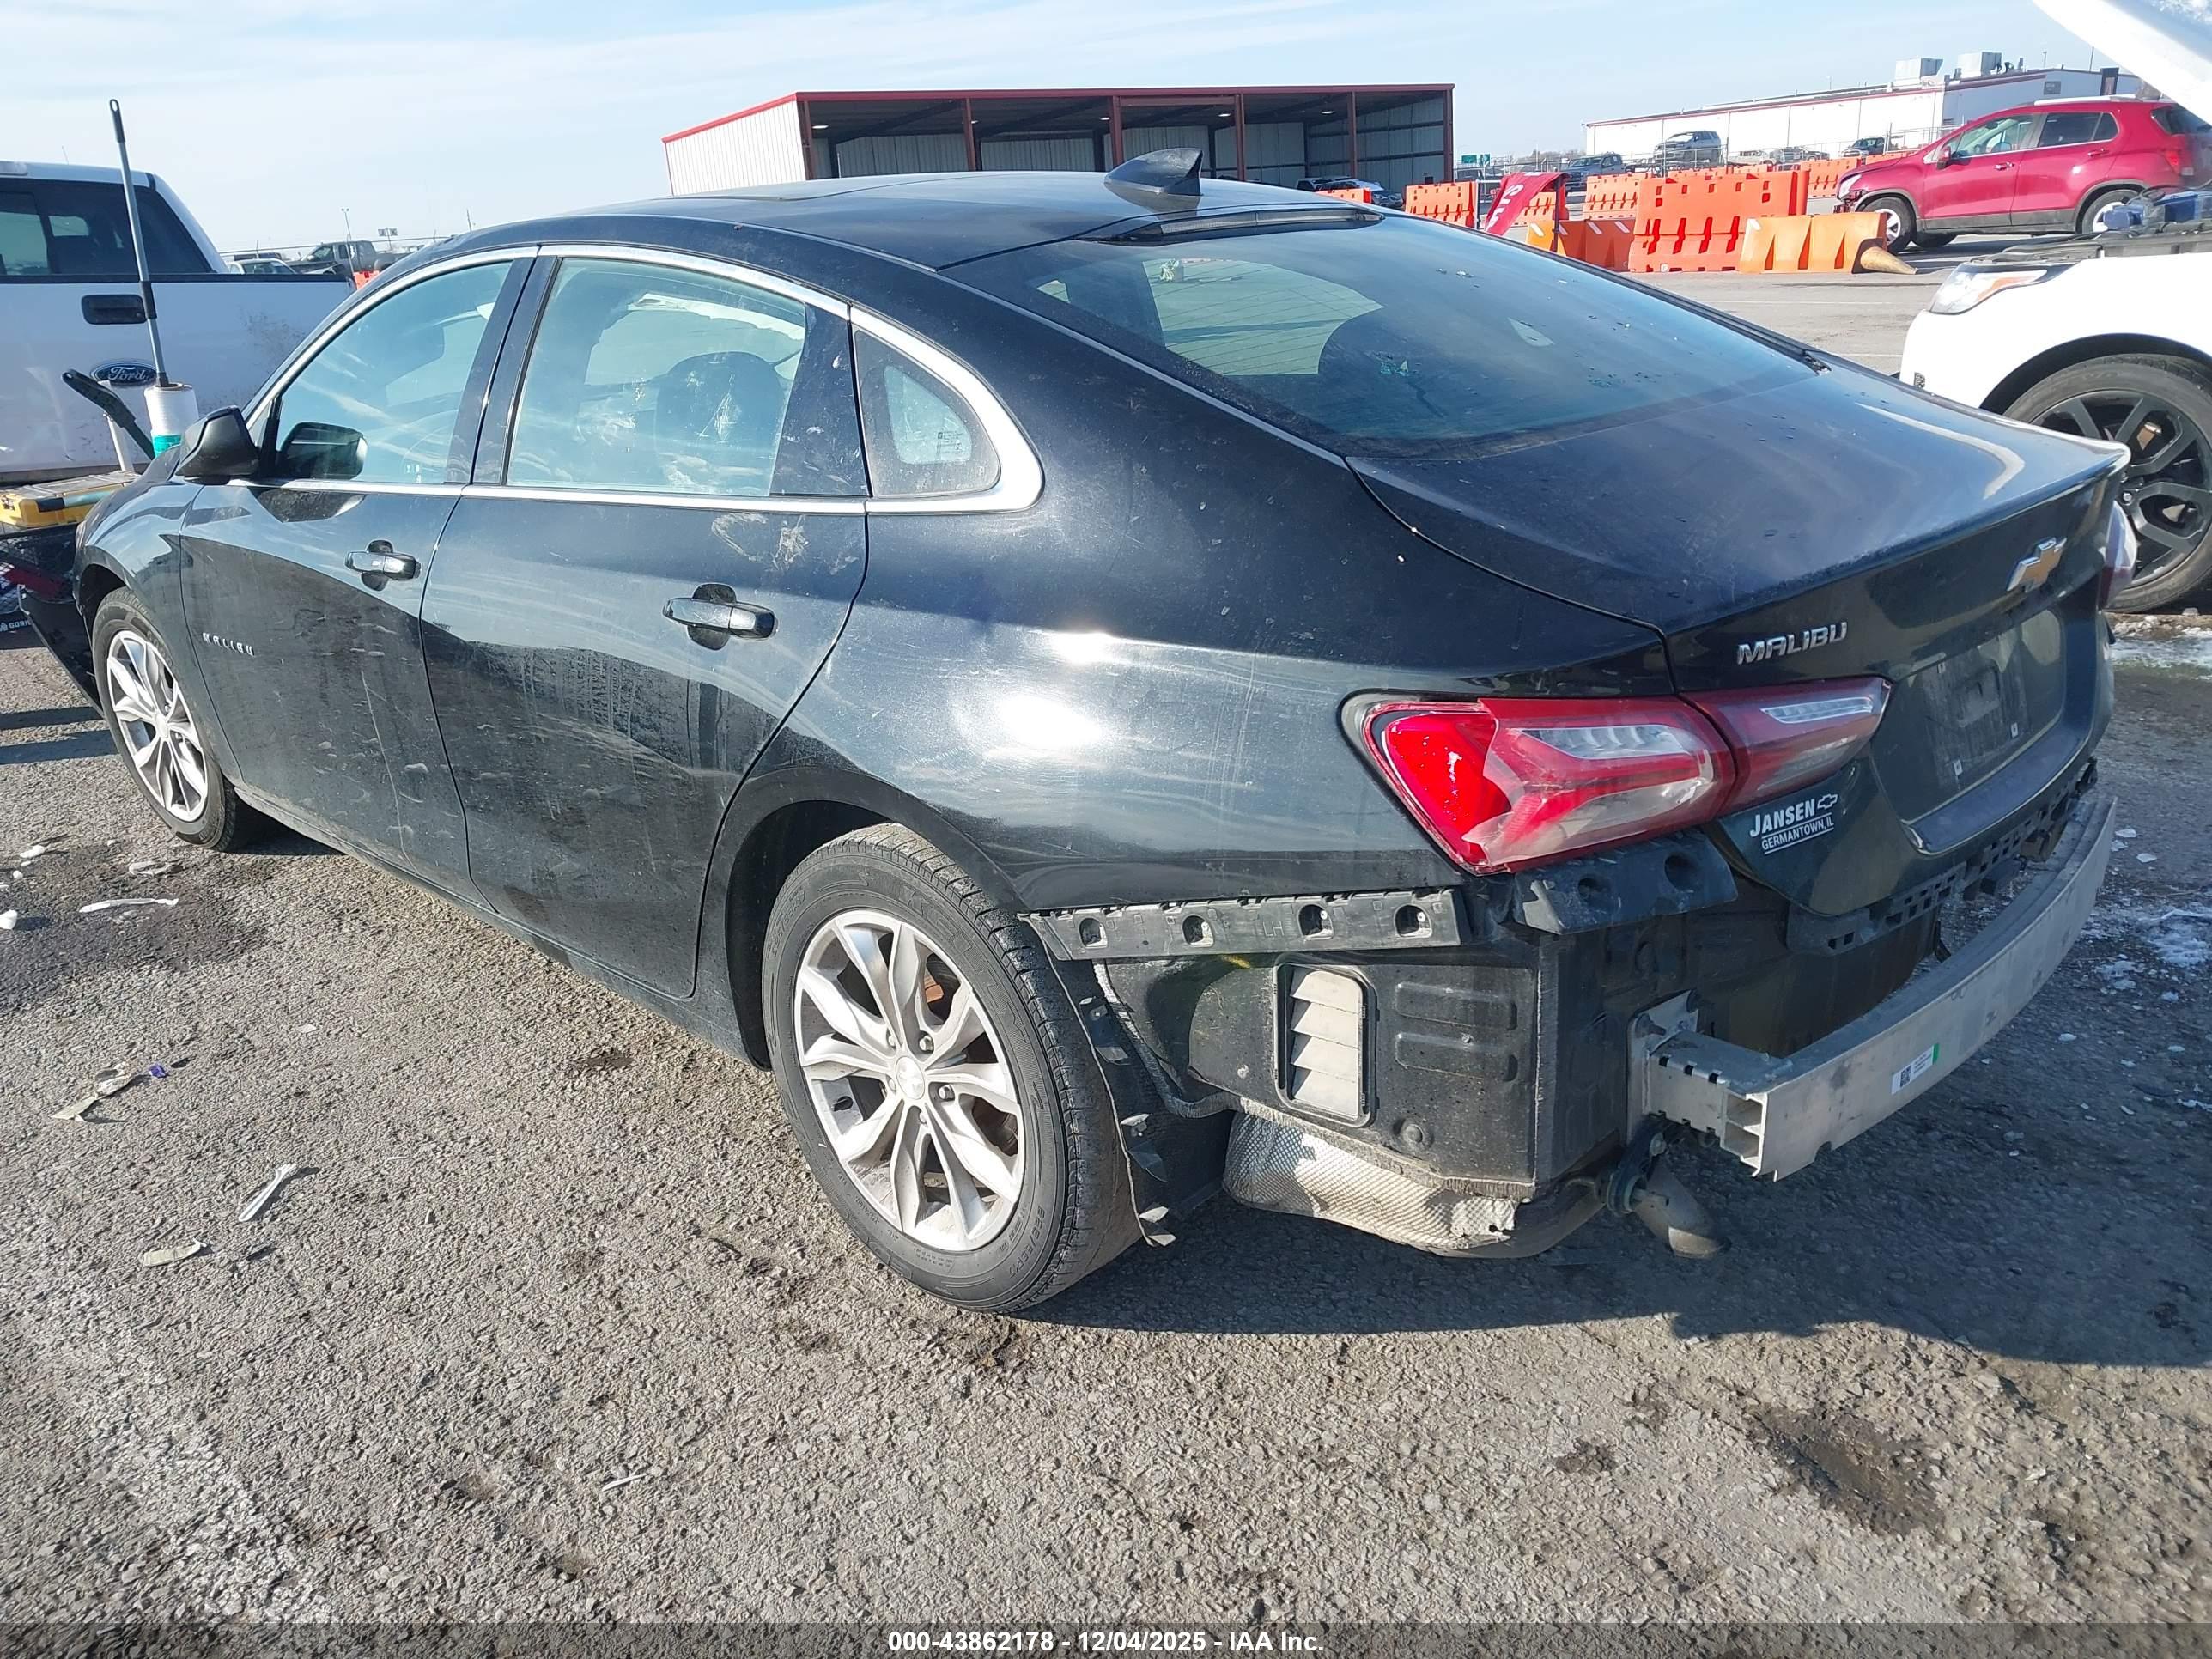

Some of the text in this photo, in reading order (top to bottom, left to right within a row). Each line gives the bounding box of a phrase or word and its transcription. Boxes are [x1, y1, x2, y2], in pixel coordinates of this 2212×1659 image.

[108, 366, 149, 381] Ford
[202, 632, 255, 657] MALIBU
[1737, 622, 1848, 665] MALIBU
[1750, 799, 1815, 837] JANSEN
[1761, 816, 1835, 851] GERMANTOWN, IL
[1262, 921, 1285, 937] LH
